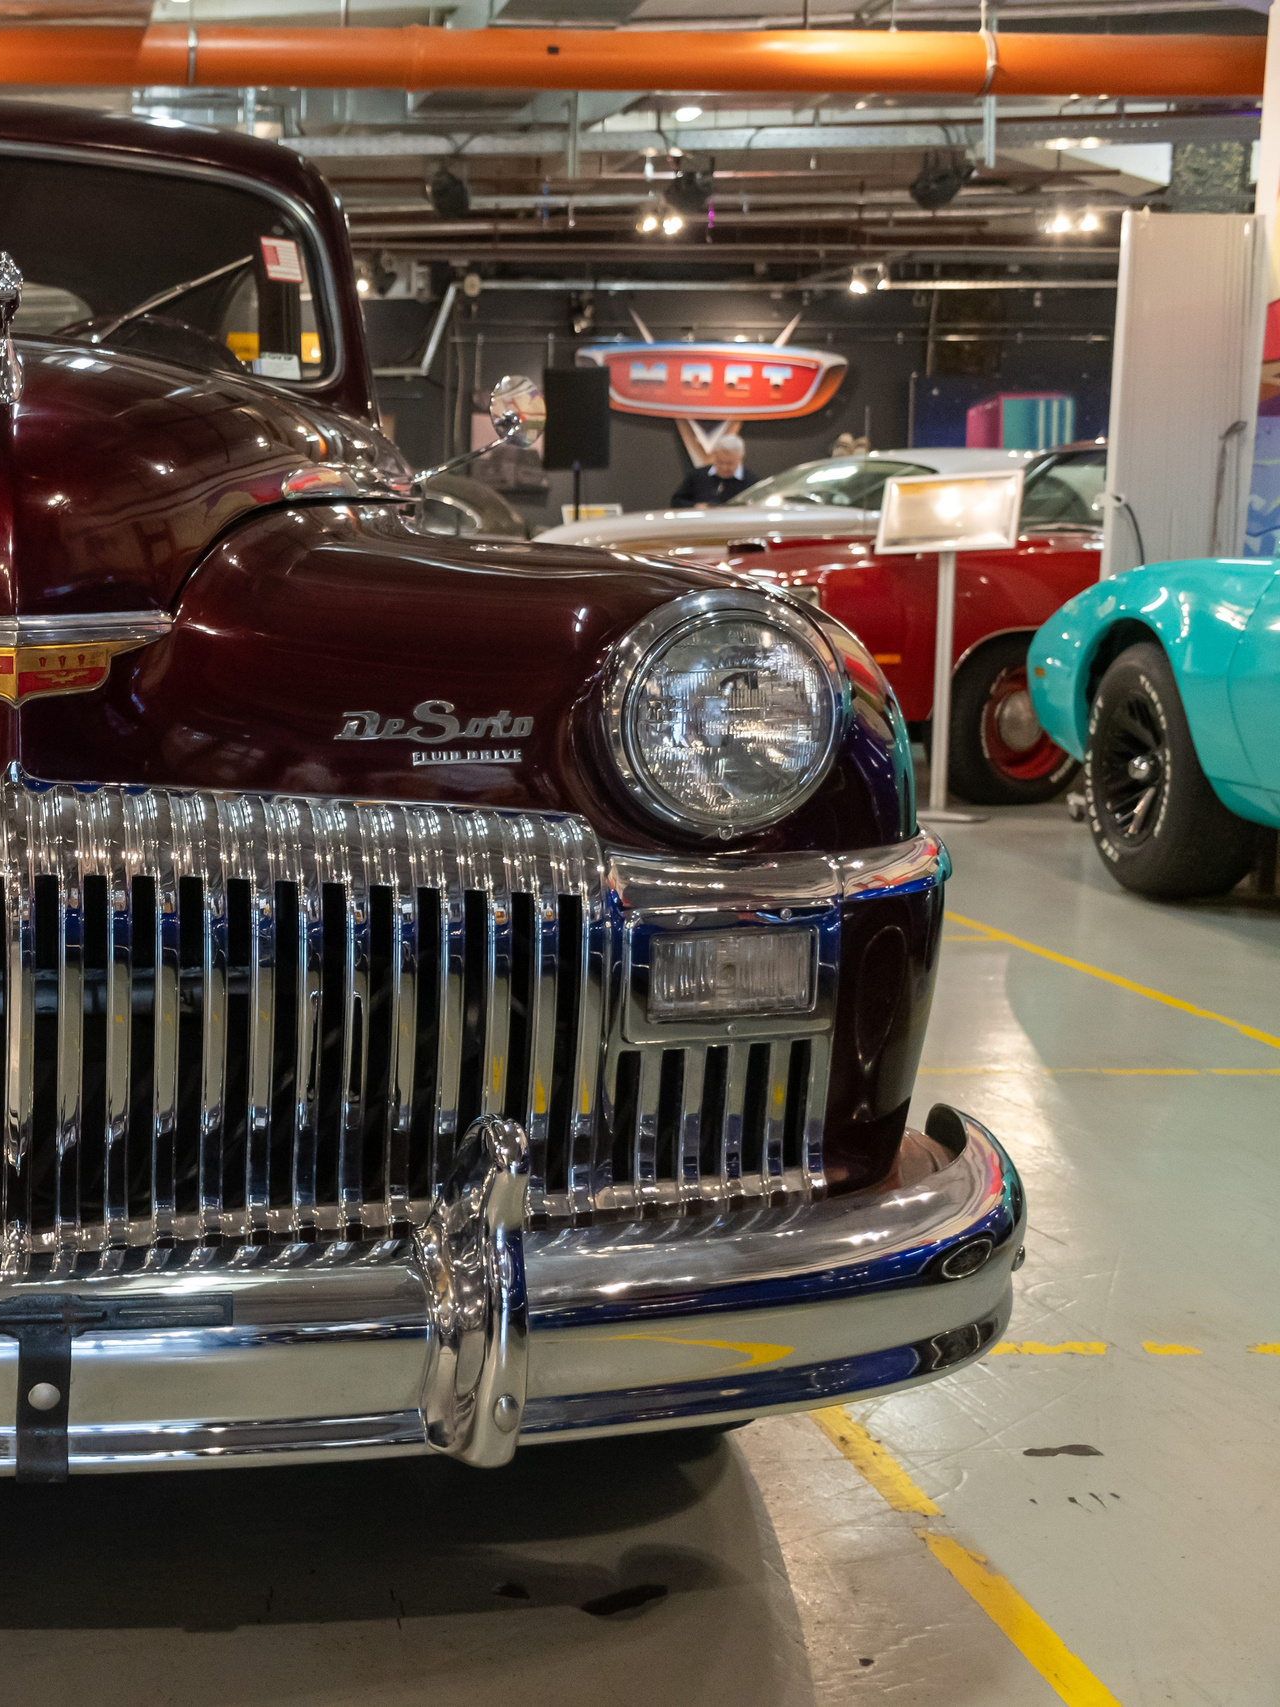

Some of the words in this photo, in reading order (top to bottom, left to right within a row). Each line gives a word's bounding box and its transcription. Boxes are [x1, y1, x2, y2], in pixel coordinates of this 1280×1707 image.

[334, 700, 534, 744] DeSoto
[412, 750, 461, 762] FLUID
[466, 749, 522, 761] DRIVE
